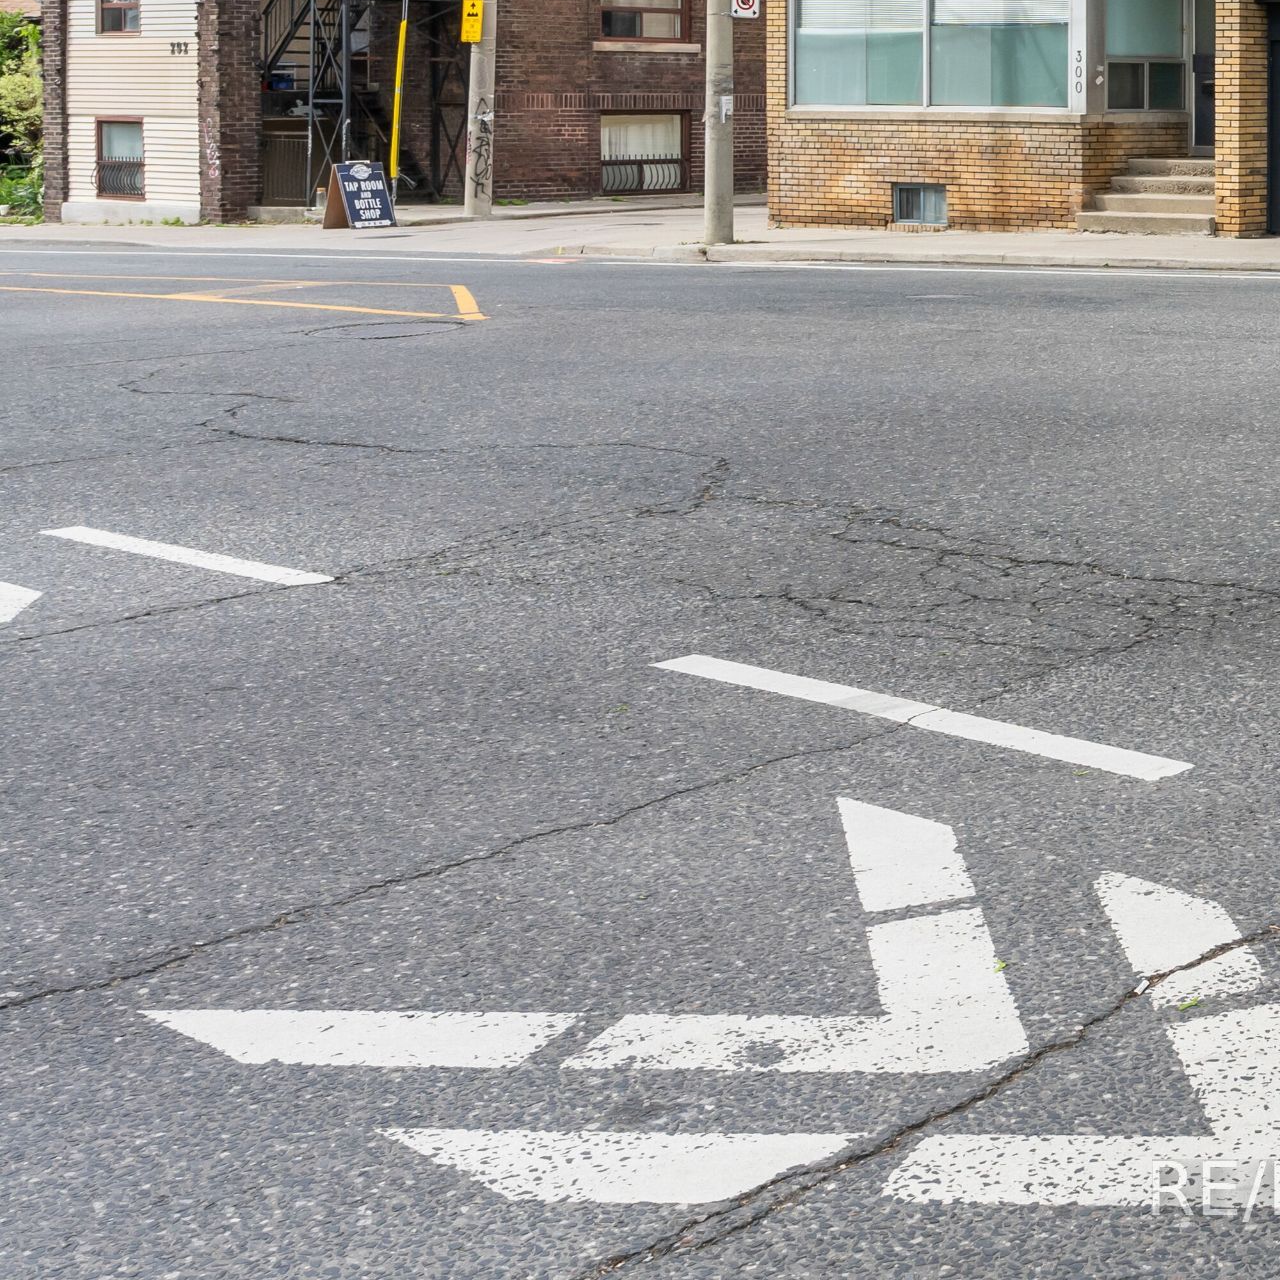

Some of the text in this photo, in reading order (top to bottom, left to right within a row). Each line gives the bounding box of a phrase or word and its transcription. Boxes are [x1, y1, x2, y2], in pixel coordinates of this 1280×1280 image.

[1075, 50, 1083, 93] 300
[344, 180, 384, 192] TAP ROOM
[354, 199, 382, 210] BOTTLE
[359, 209, 381, 219] SHOP
